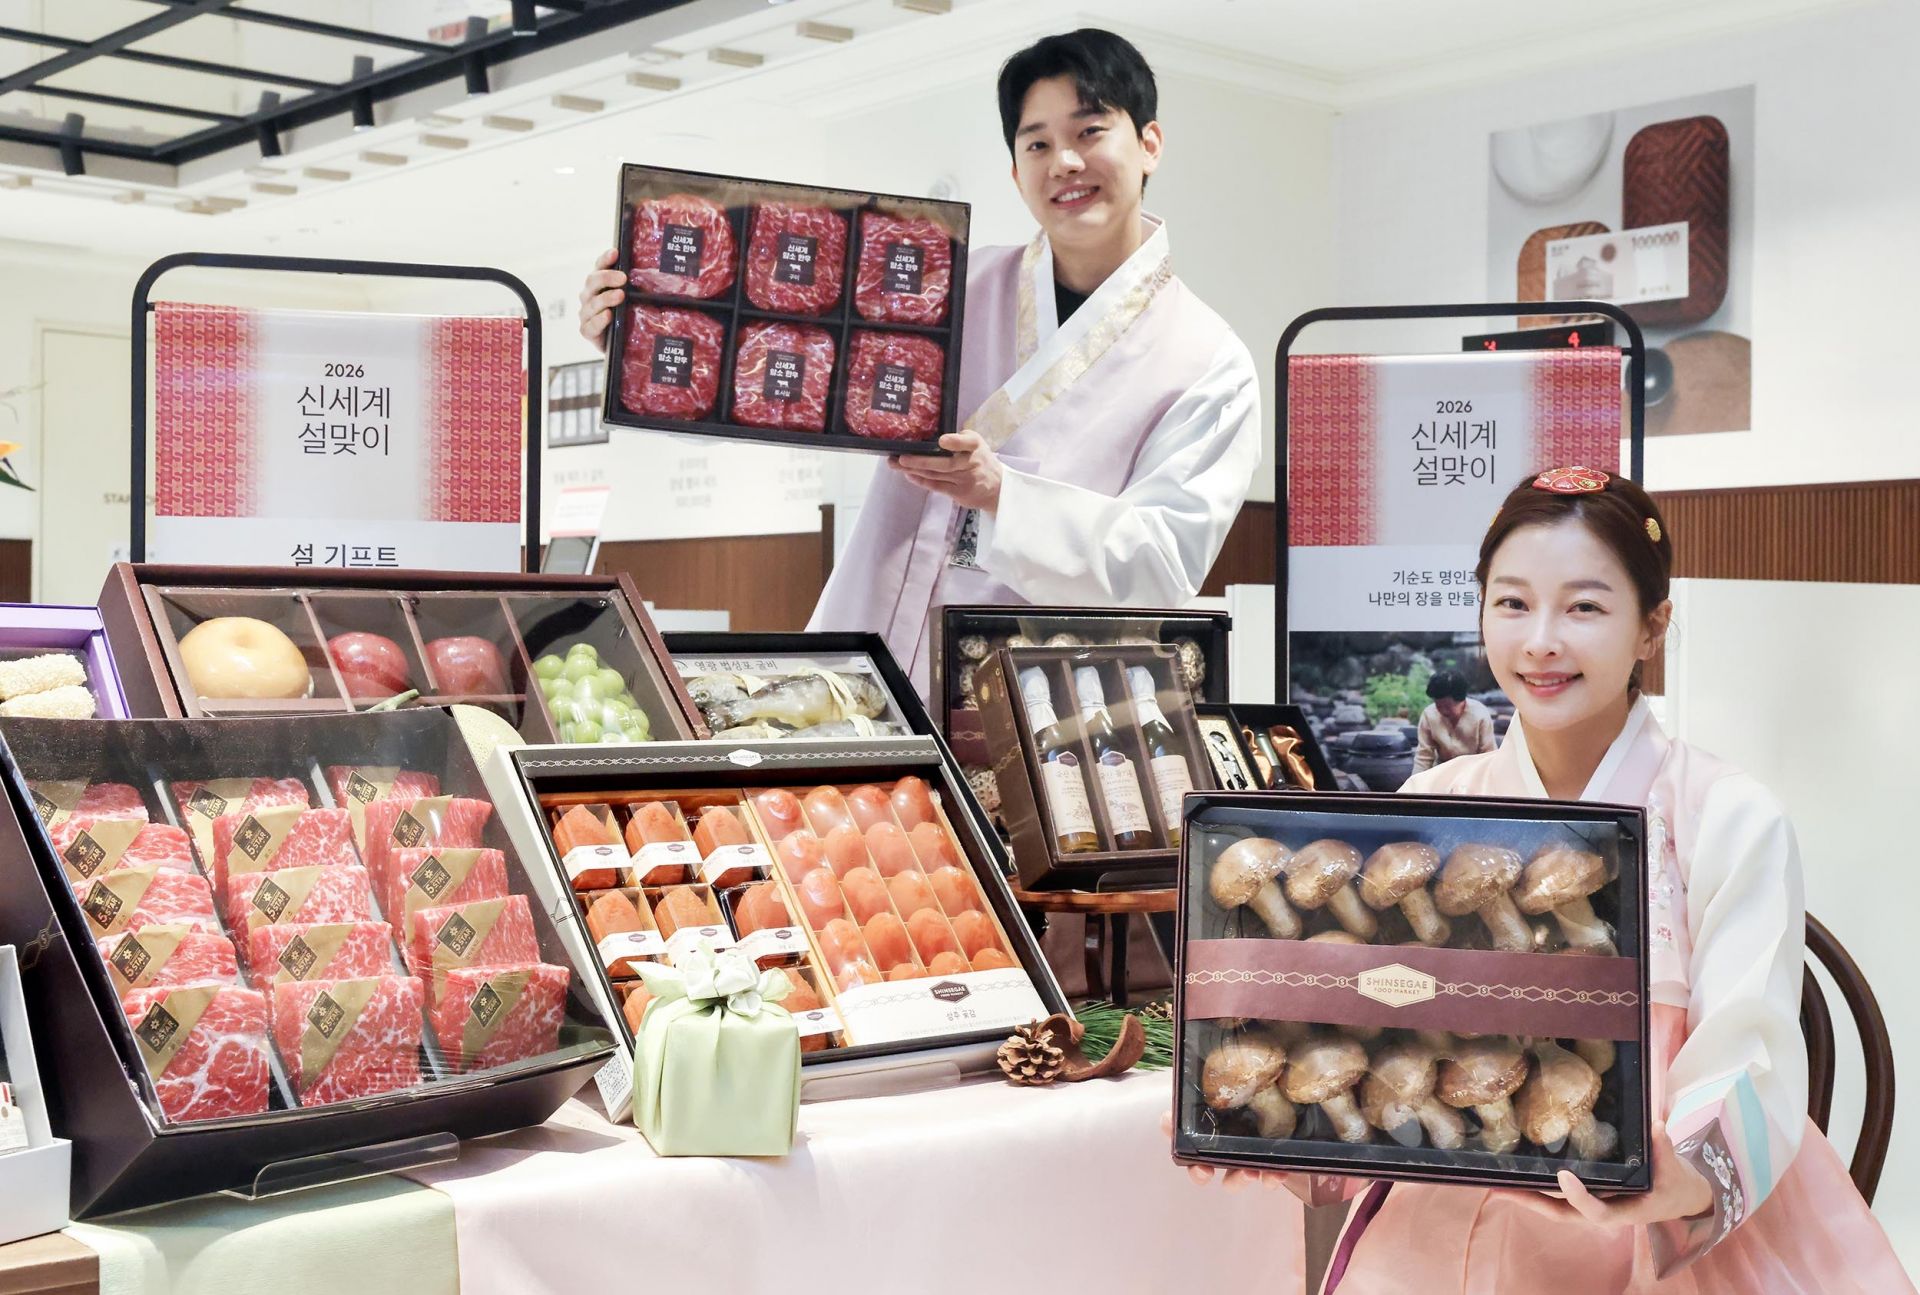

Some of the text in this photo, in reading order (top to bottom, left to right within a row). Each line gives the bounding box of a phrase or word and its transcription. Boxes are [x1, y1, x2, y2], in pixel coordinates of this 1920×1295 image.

[672, 235, 694, 245] 신세계
[787, 244, 809, 255] 신세계
[895, 254, 915, 264] 신세계
[663, 346, 685, 356] 신세계
[324, 363, 365, 378] 2026
[774, 361, 796, 371] 신세계
[884, 373, 905, 384] 신세계
[297, 384, 390, 419] 신세계
[1436, 400, 1473, 414] 2026
[298, 422, 389, 456] 설맞이
[1411, 420, 1496, 451] 신세계
[1412, 454, 1495, 486] 설맞이
[324, 543, 399, 568] 기프트
[1392, 570, 1435, 585] 기순도
[1368, 591, 1483, 606] 나만의 장을 만들
[694, 659, 778, 671] 영광 법성포 굴비
[1366, 977, 1429, 990] SHINSEGAE
